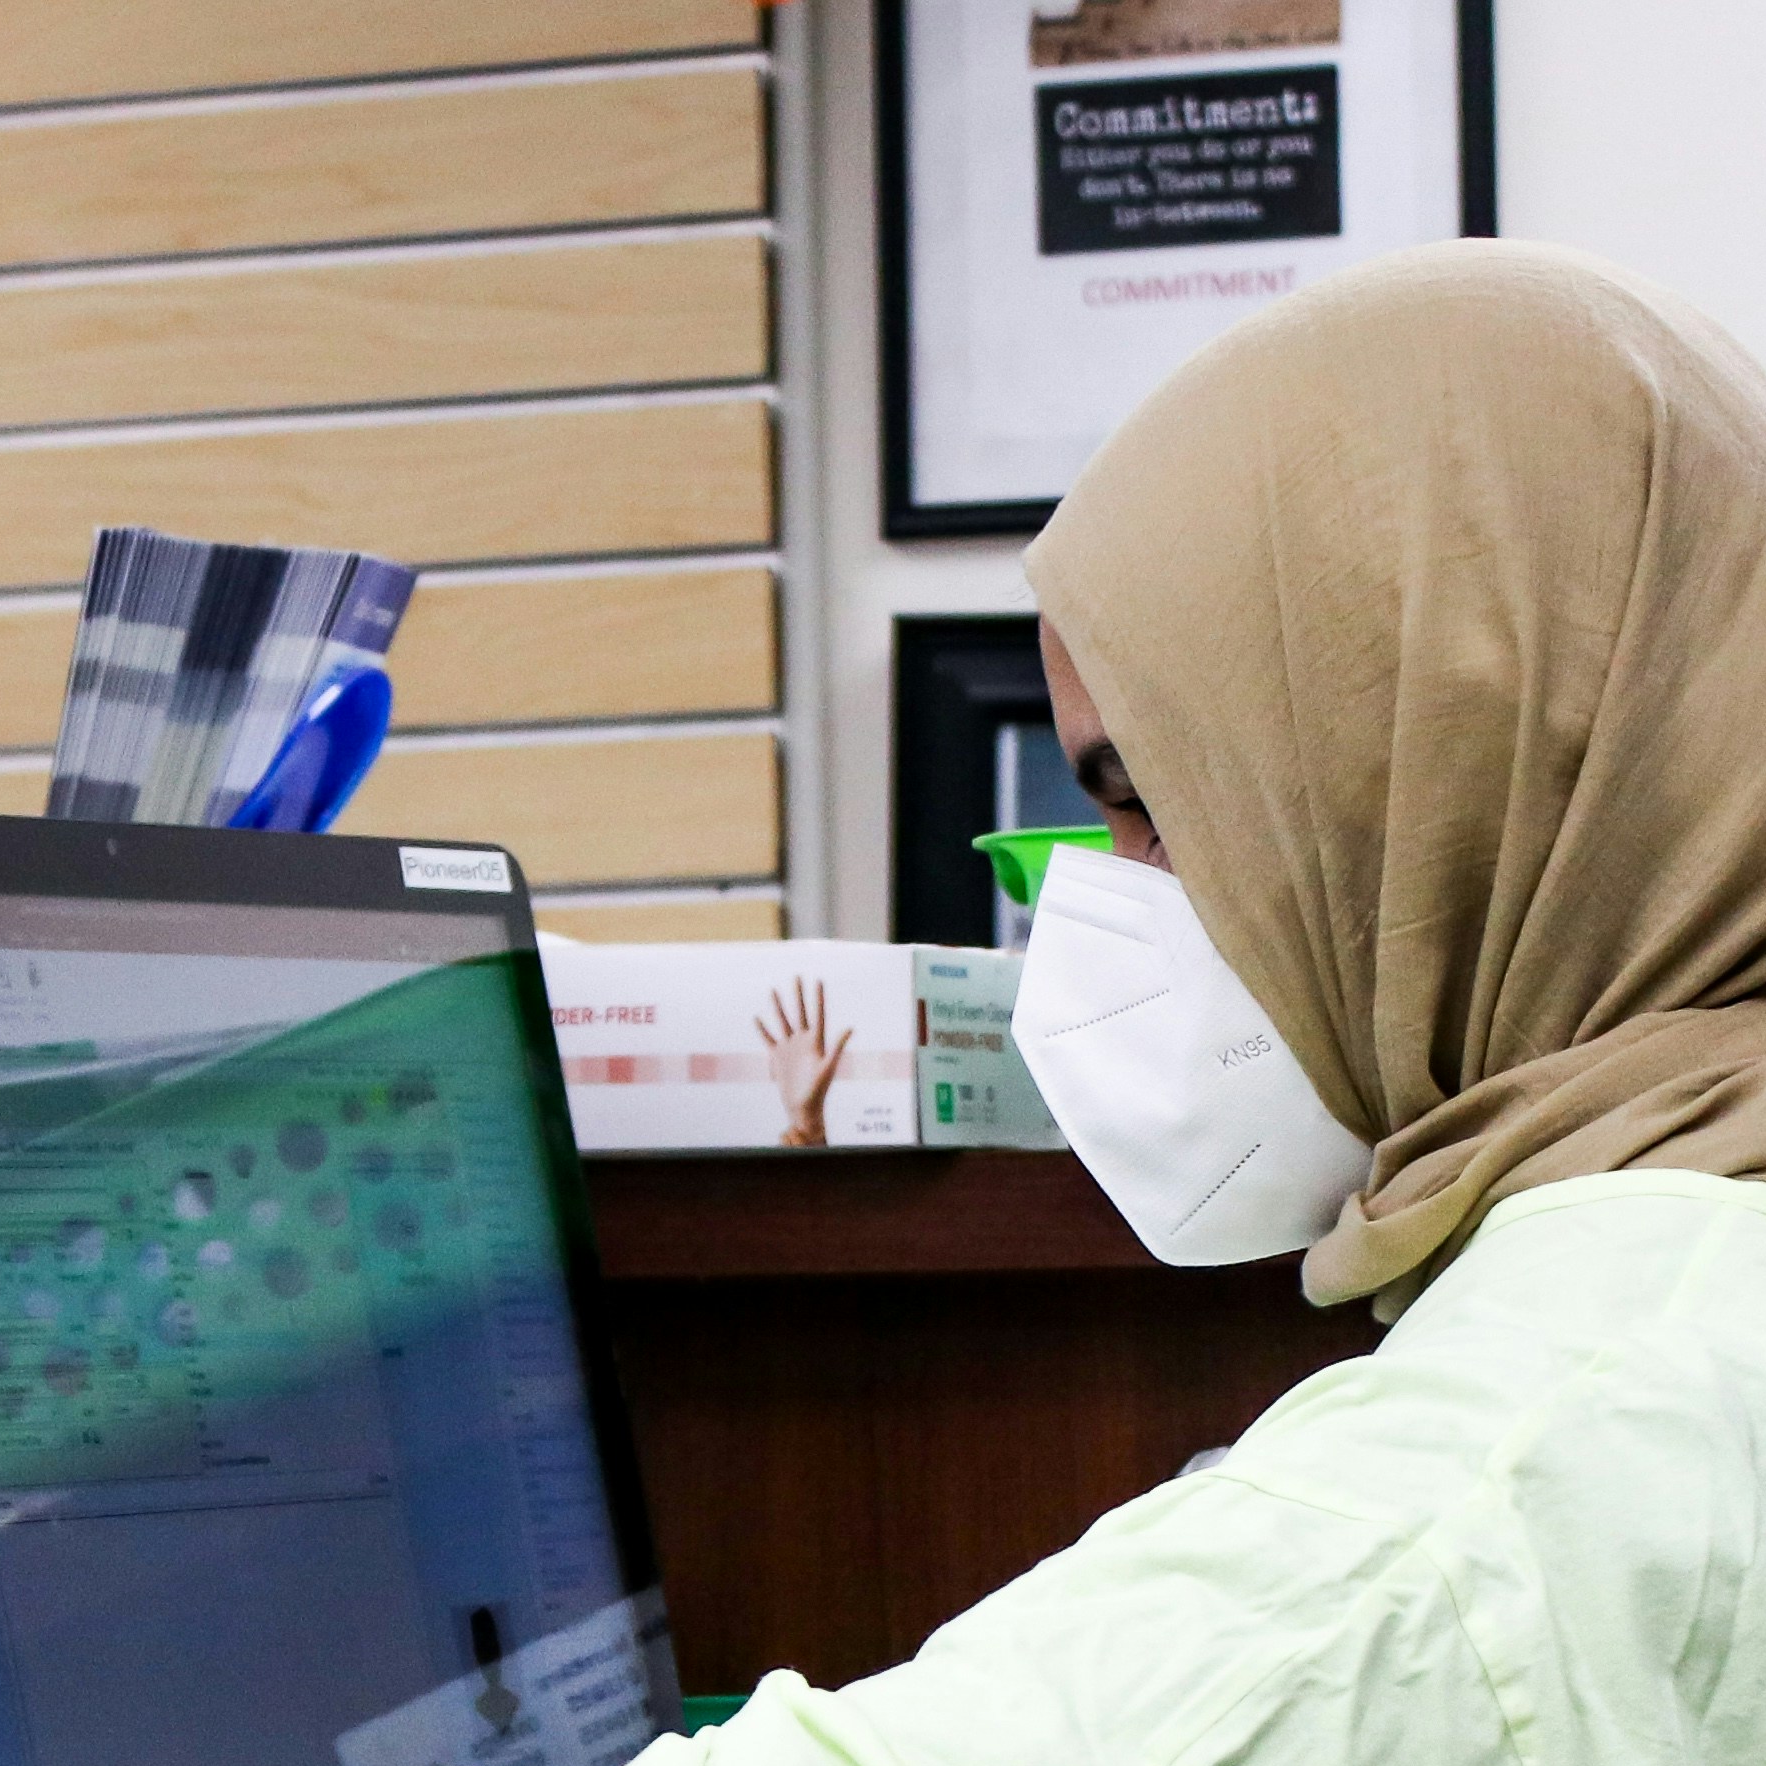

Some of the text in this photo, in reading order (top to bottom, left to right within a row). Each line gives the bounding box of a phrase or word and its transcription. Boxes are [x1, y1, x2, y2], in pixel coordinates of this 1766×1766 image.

[1082, 265, 1297, 308] COMMITMENT
[404, 857, 504, 883] Pioneer05
[1217, 1033, 1273, 1071] KN95
